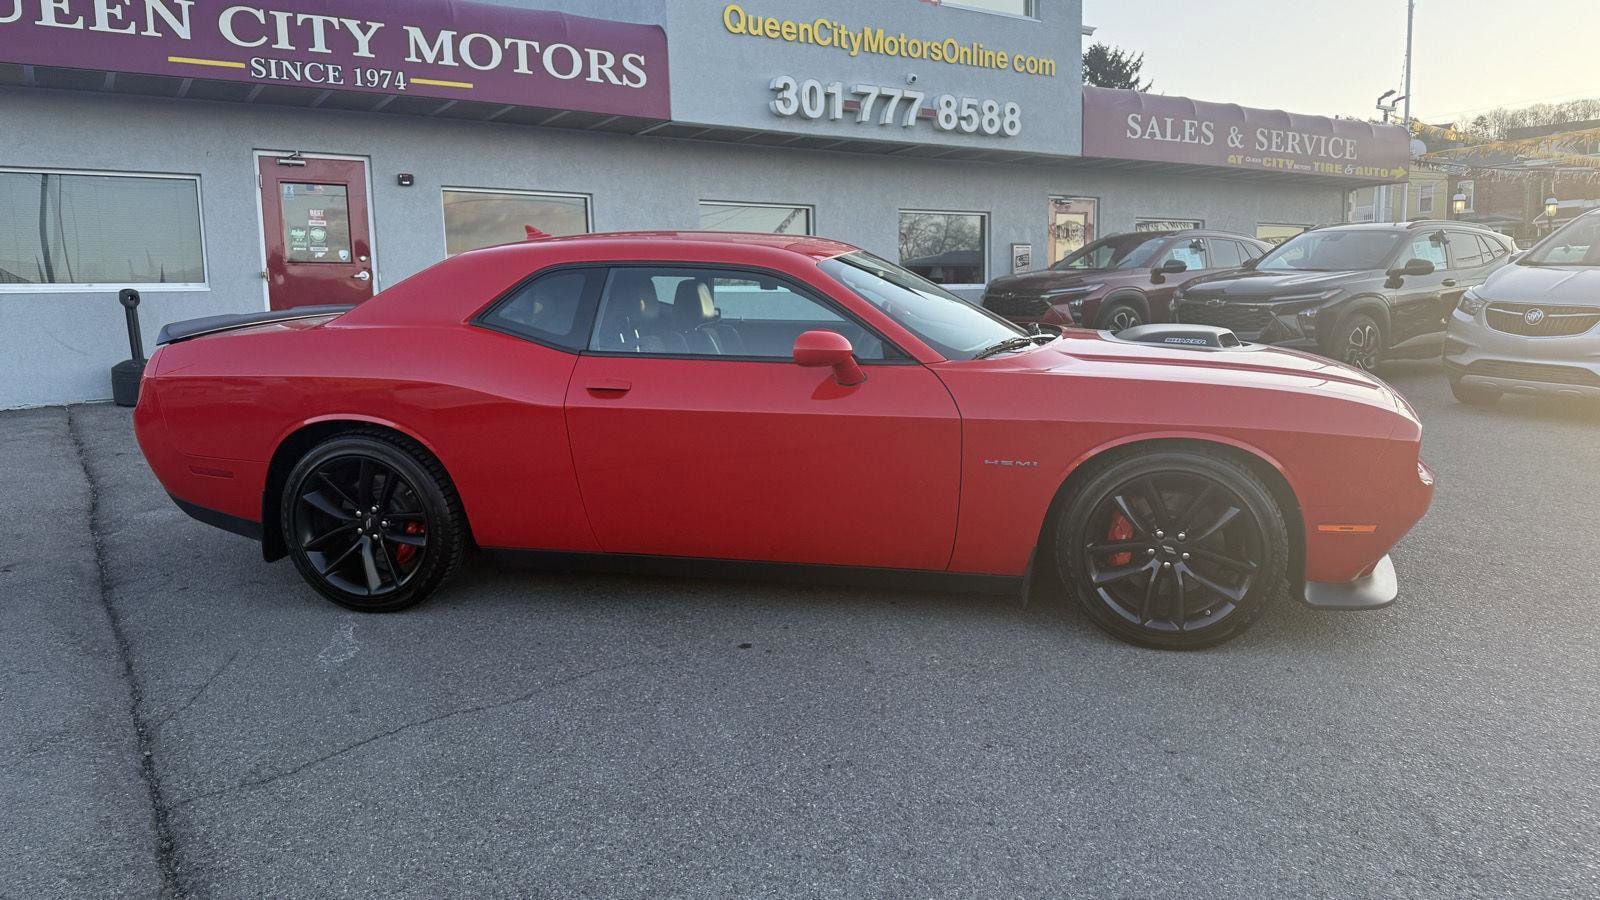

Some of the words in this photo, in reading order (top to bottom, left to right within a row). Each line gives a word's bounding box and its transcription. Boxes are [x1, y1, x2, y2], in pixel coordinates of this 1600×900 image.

[218, 5, 386, 58] CITY
[403, 25, 648, 88] MOTORS
[723, 4, 1008, 69] QueenCityMotorsOnline
[250, 57, 344, 86] SINCE
[353, 68, 407, 91] 1974
[1126, 113, 1215, 146] SALES
[1226, 126, 1245, 149] &
[1255, 127, 1358, 161] SERVICE
[1227, 154, 1244, 165] AT
[1262, 156, 1295, 169] CITY
[1314, 161, 1343, 174] TIRE
[1344, 164, 1356, 175] &
[1355, 166, 1389, 178] AUTO
[984, 459, 1039, 467] HEMI
